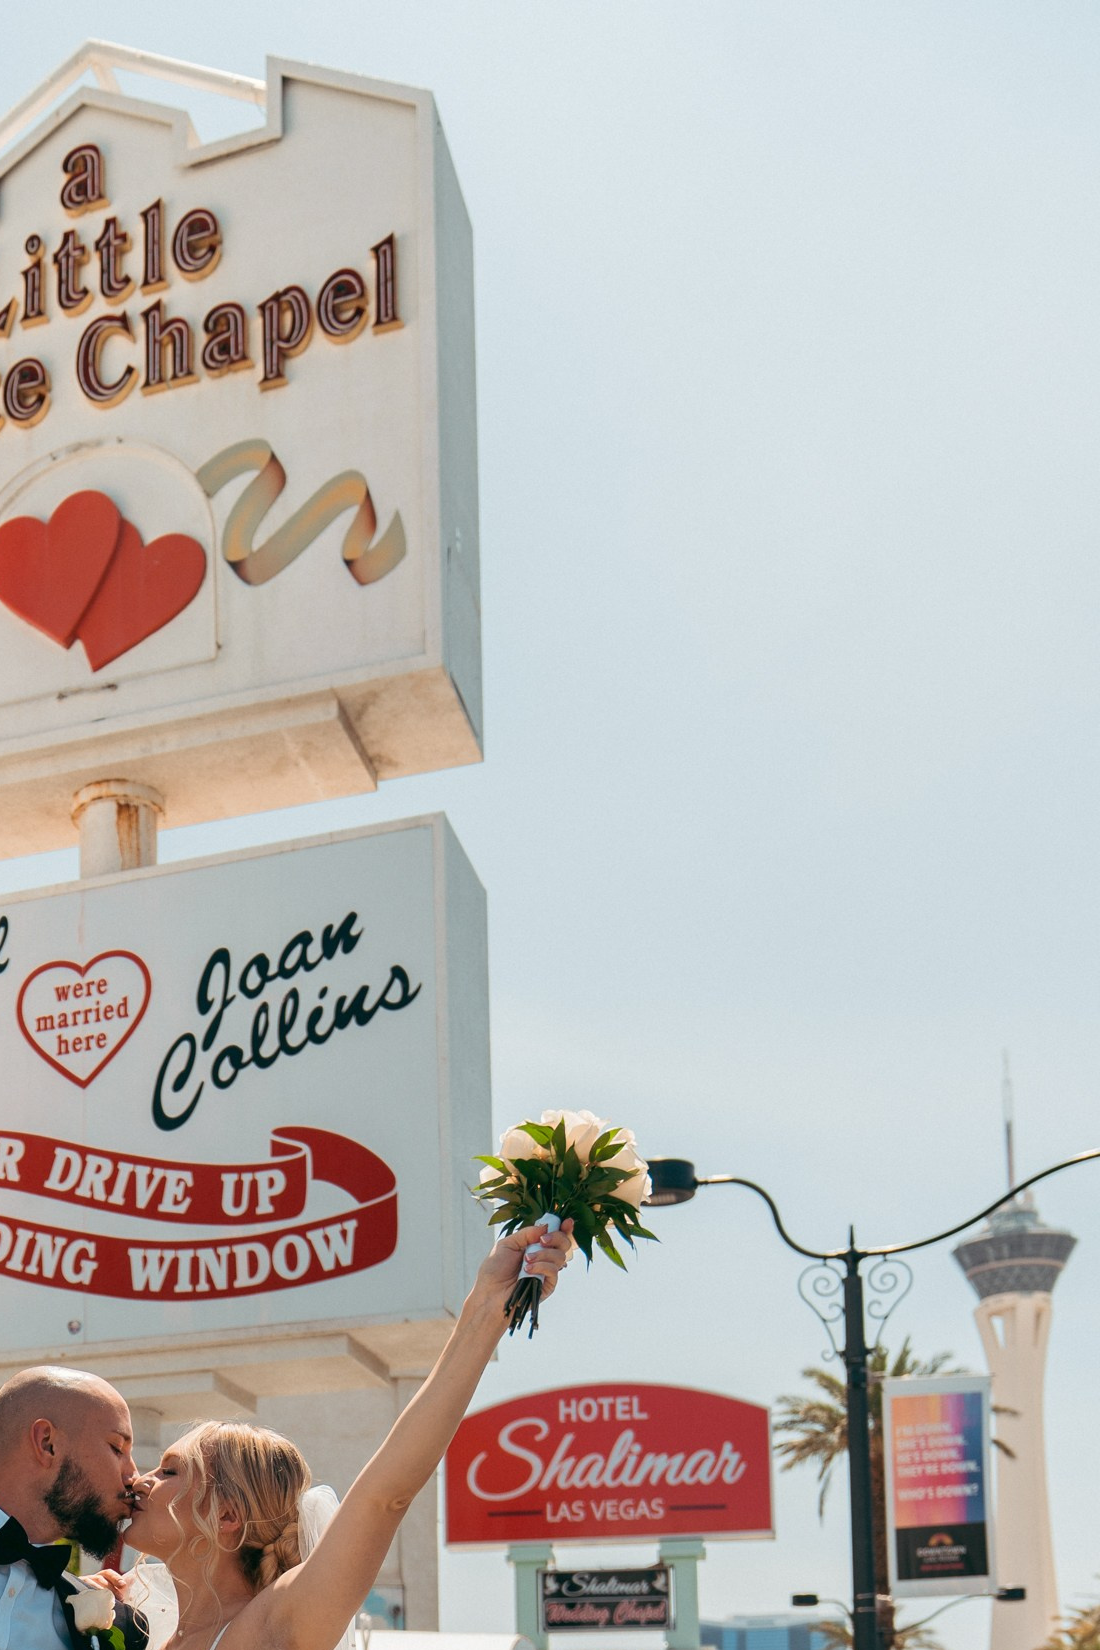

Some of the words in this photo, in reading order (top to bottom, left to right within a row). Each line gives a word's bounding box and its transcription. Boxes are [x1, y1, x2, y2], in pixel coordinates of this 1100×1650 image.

[60, 143, 109, 216] a
[77, 233, 404, 410] Chapel
[35, 996, 129, 1032] married
[54, 978, 108, 1002] were
[195, 911, 364, 1052] Joan
[57, 1032, 107, 1056] here
[152, 964, 422, 1131] Collins
[44, 1148, 193, 1215] DRIVE
[220, 1168, 287, 1217] UP
[128, 1219, 359, 1294] WINDOW
[559, 1396, 648, 1423] HOTEL
[467, 1417, 747, 1501] Shalimar
[546, 1502, 586, 1523] LAS
[593, 1498, 665, 1521] VEGAS
[562, 1572, 650, 1597] Shalimar
